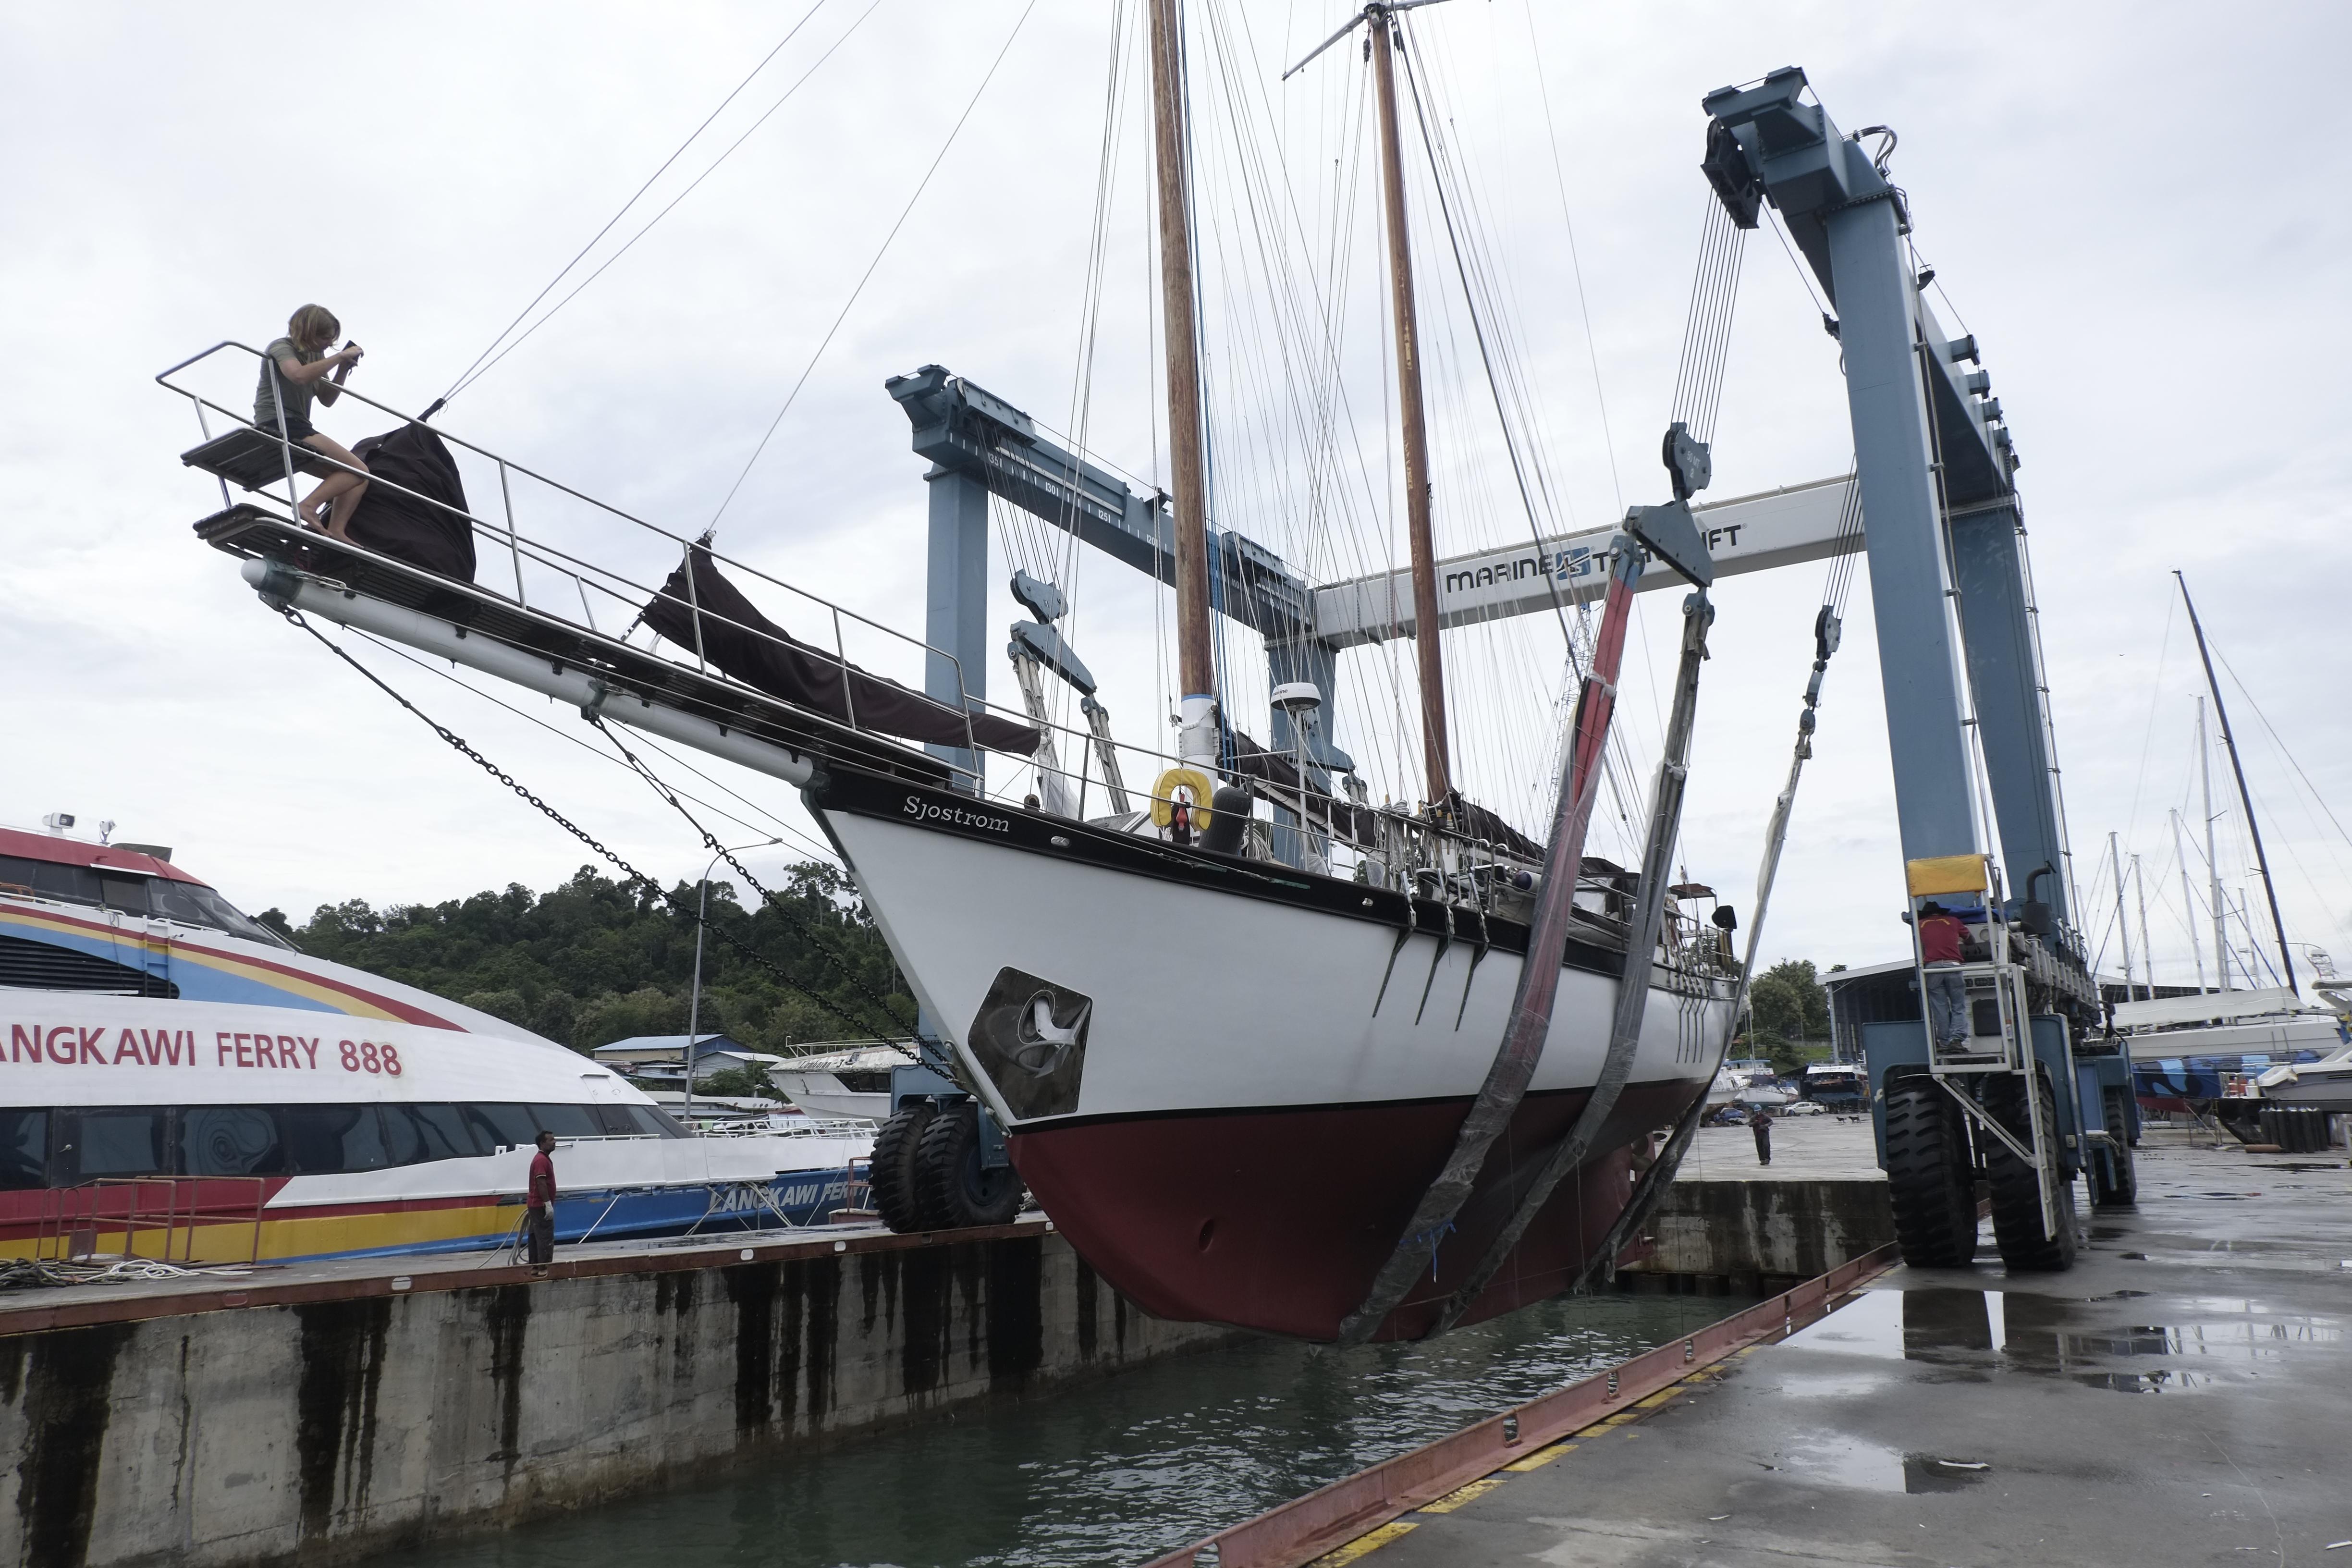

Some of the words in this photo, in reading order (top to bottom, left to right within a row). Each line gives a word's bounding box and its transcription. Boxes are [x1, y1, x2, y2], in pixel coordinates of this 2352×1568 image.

[1446, 553, 1554, 593] MARINE
[903, 796, 1009, 832] Sjostrom
[0, 1024, 196, 1066] NGKAWI
[216, 1032, 319, 1069] FERRY
[338, 1039, 403, 1076] 888
[708, 1184, 819, 1213] LANGKAWI
